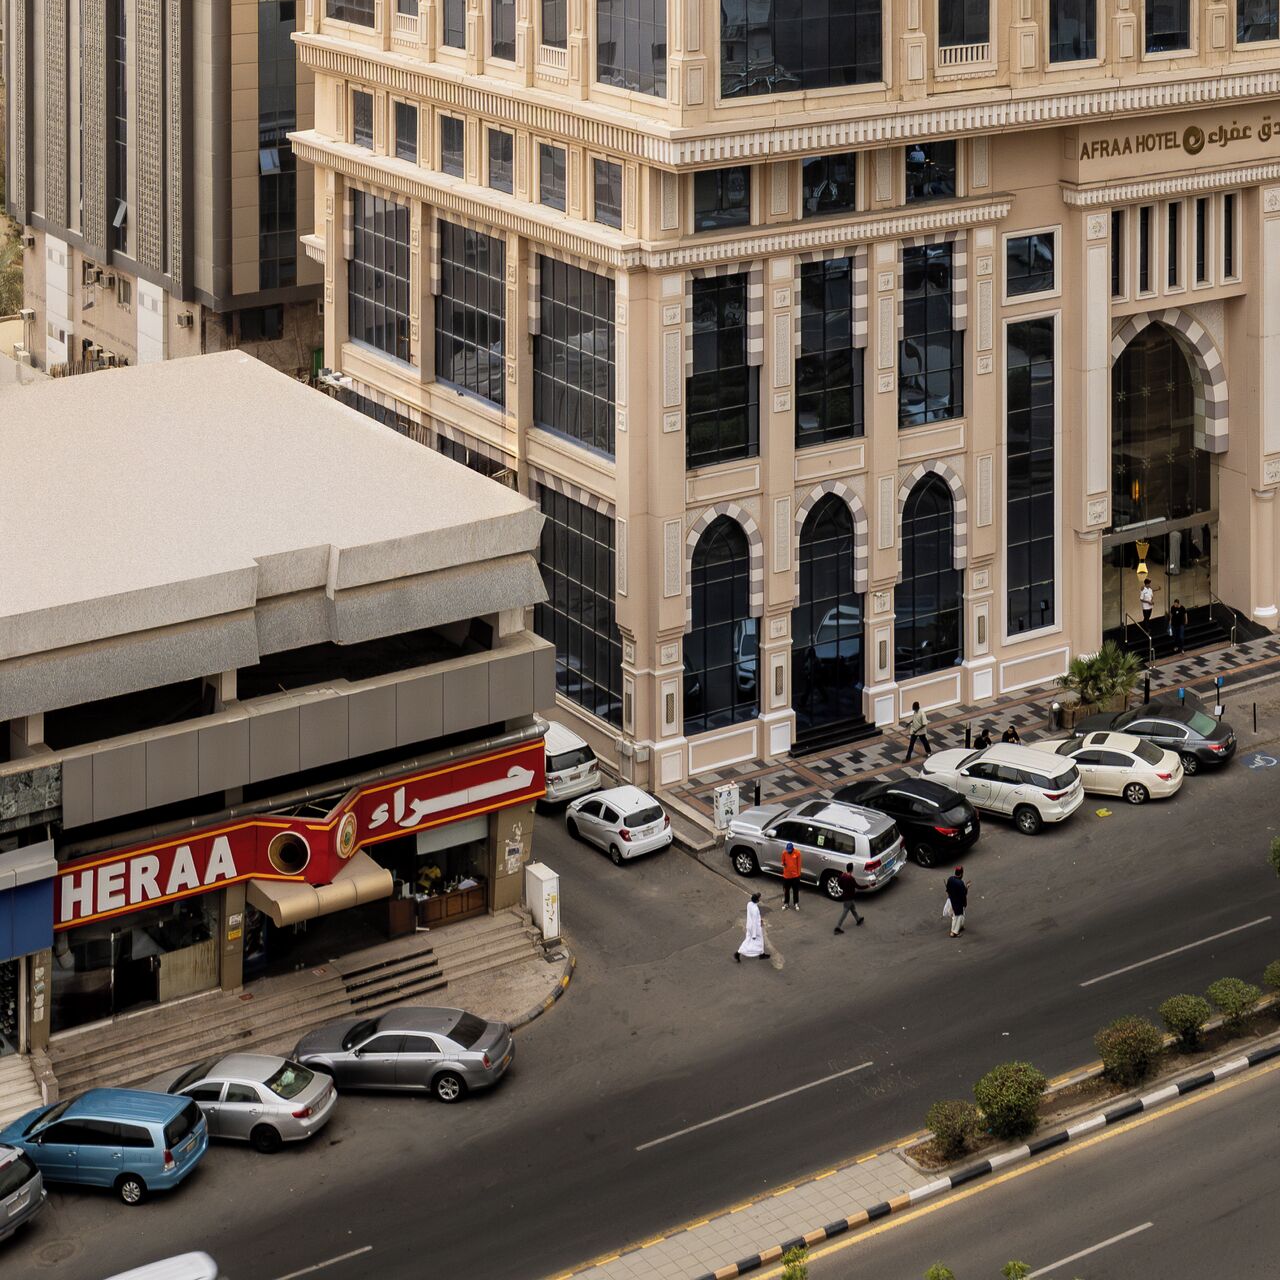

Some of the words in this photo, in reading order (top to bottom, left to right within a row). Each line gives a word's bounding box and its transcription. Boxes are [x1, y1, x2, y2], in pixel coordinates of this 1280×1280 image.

[1080, 137, 1133, 161] AFRAA
[1135, 131, 1181, 153] HOTEL
[1207, 120, 1252, 147] عفراء
[368, 765, 535, 830] حراء
[60, 835, 238, 922] HERAA
